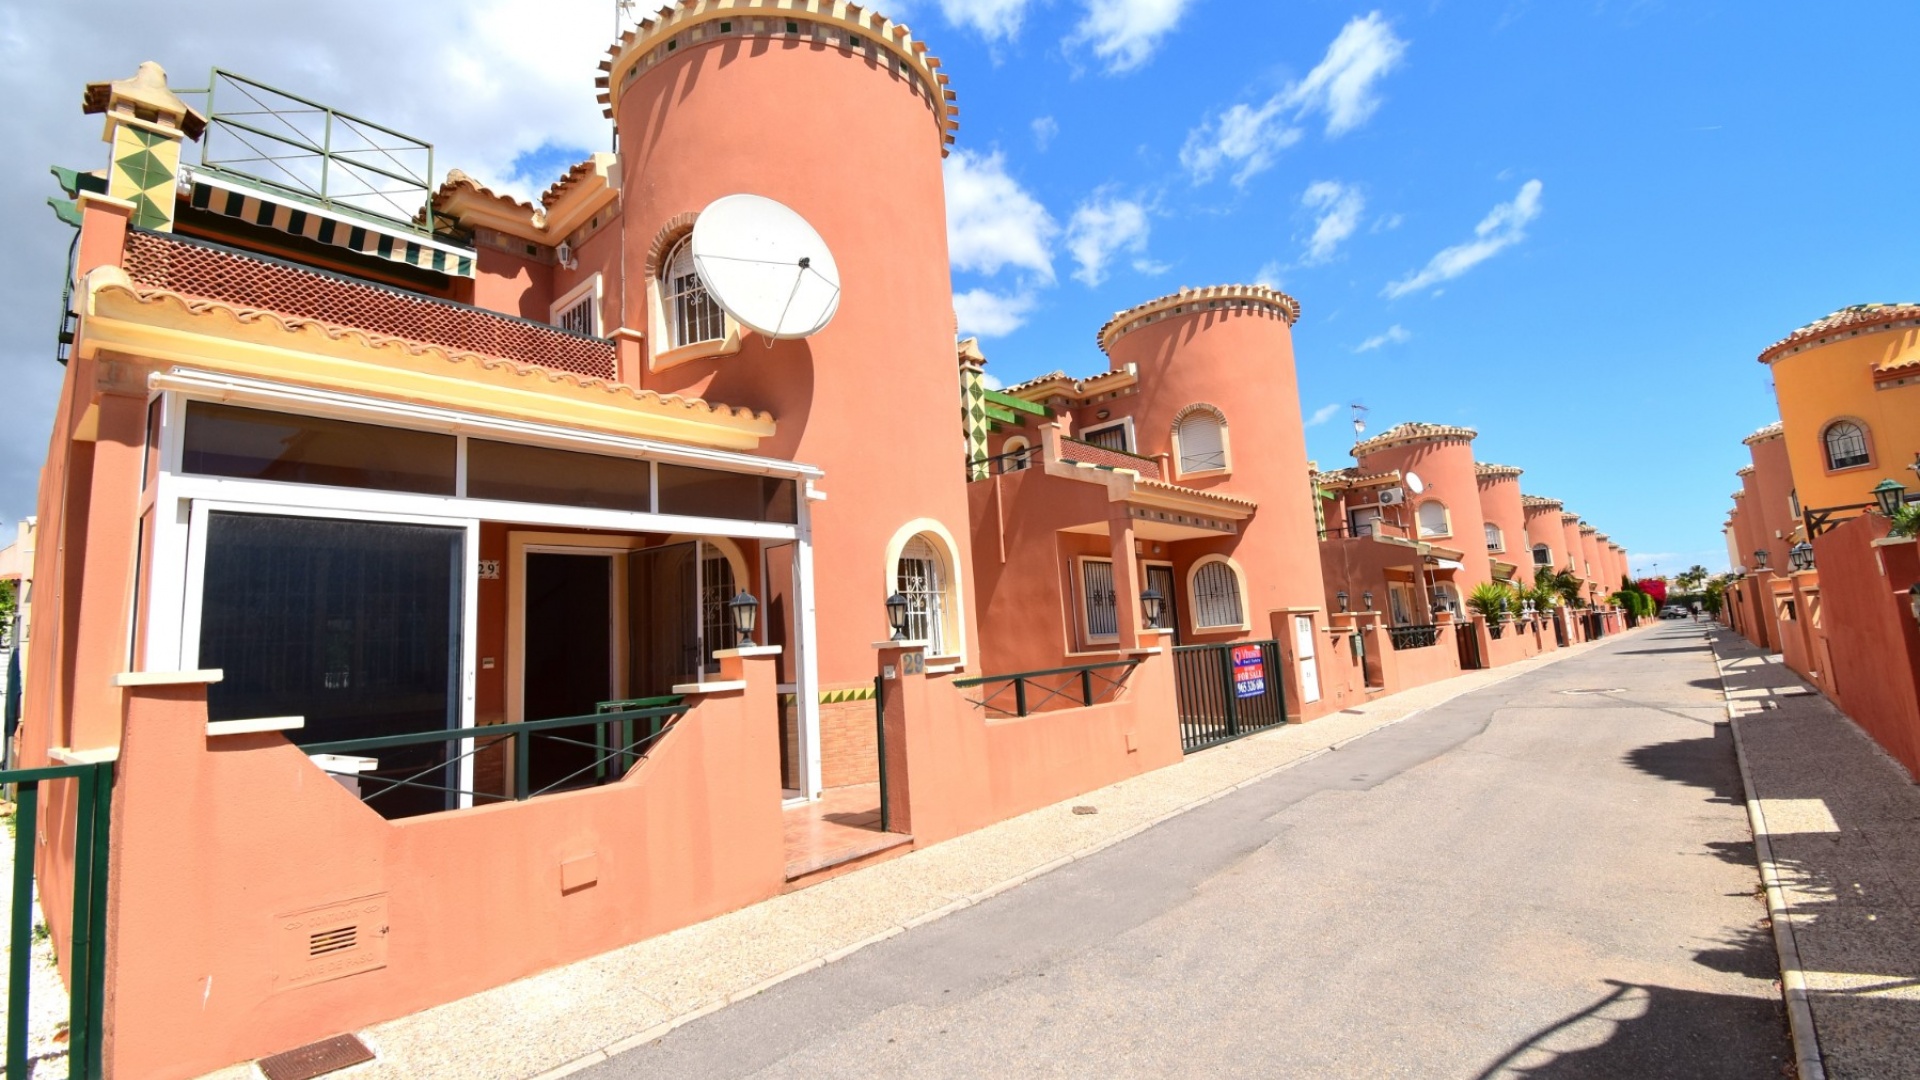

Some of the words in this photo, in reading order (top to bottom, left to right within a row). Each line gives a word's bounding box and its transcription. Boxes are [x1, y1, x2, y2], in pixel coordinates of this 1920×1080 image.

[478, 564, 494, 575] 29
[903, 653, 923, 675] 29
[1238, 672, 1249, 682] FOR
[1250, 670, 1263, 679] SALE
[308, 909, 359, 927] CONTADOR
[328, 959, 343, 972] DE
[346, 952, 375, 968] PASO
